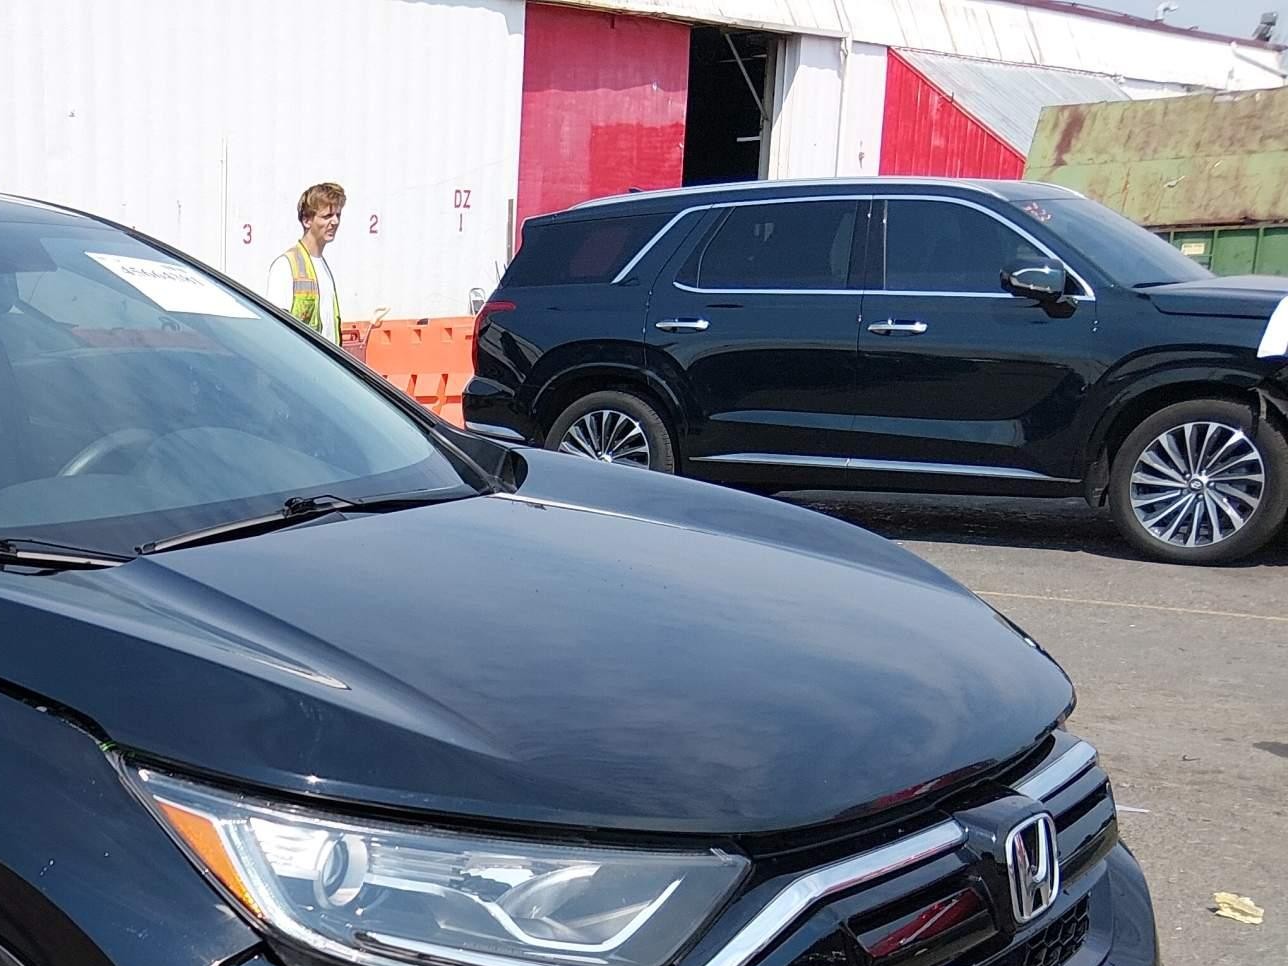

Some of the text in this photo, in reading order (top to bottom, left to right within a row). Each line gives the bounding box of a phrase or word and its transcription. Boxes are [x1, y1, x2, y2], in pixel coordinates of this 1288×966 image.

[454, 189, 471, 208] DZ
[242, 223, 252, 244] 3
[369, 214, 379, 234] 2
